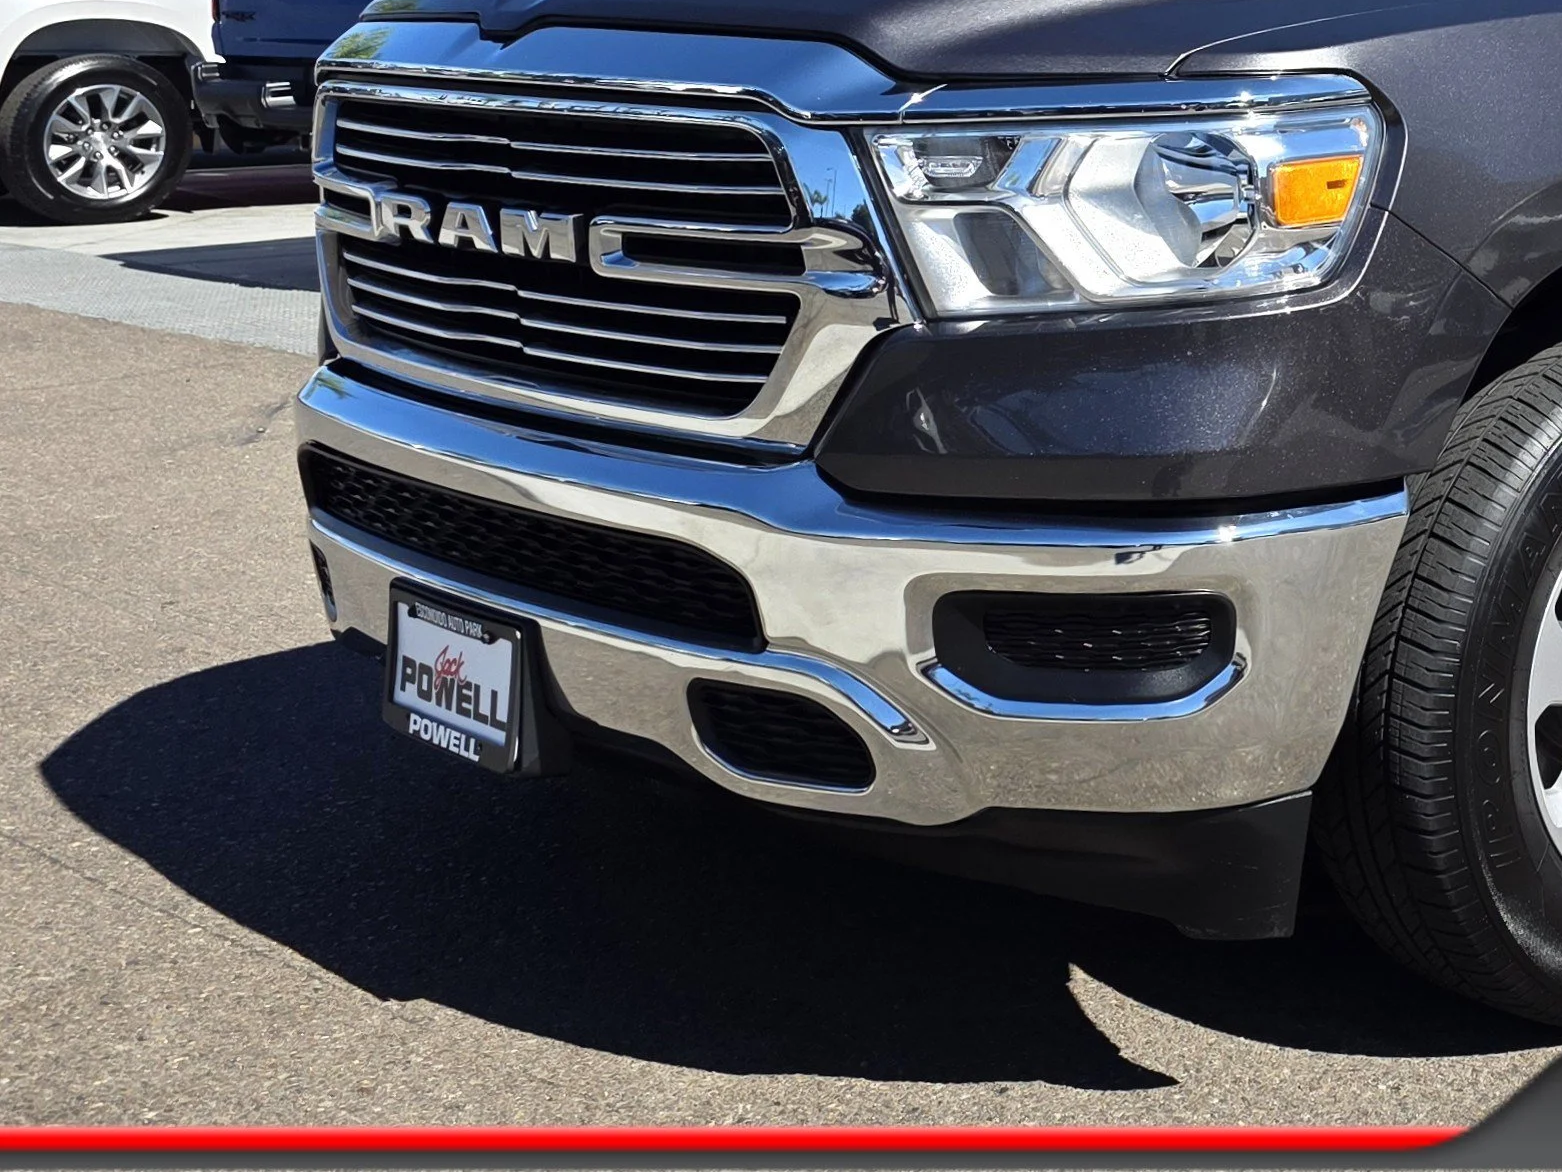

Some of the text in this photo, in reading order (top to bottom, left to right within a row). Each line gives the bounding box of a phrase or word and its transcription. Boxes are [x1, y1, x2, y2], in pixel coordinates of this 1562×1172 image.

[378, 193, 584, 263] RAM
[400, 655, 508, 733] POWELL
[434, 645, 467, 692] Jack
[409, 713, 480, 762] POWELL
